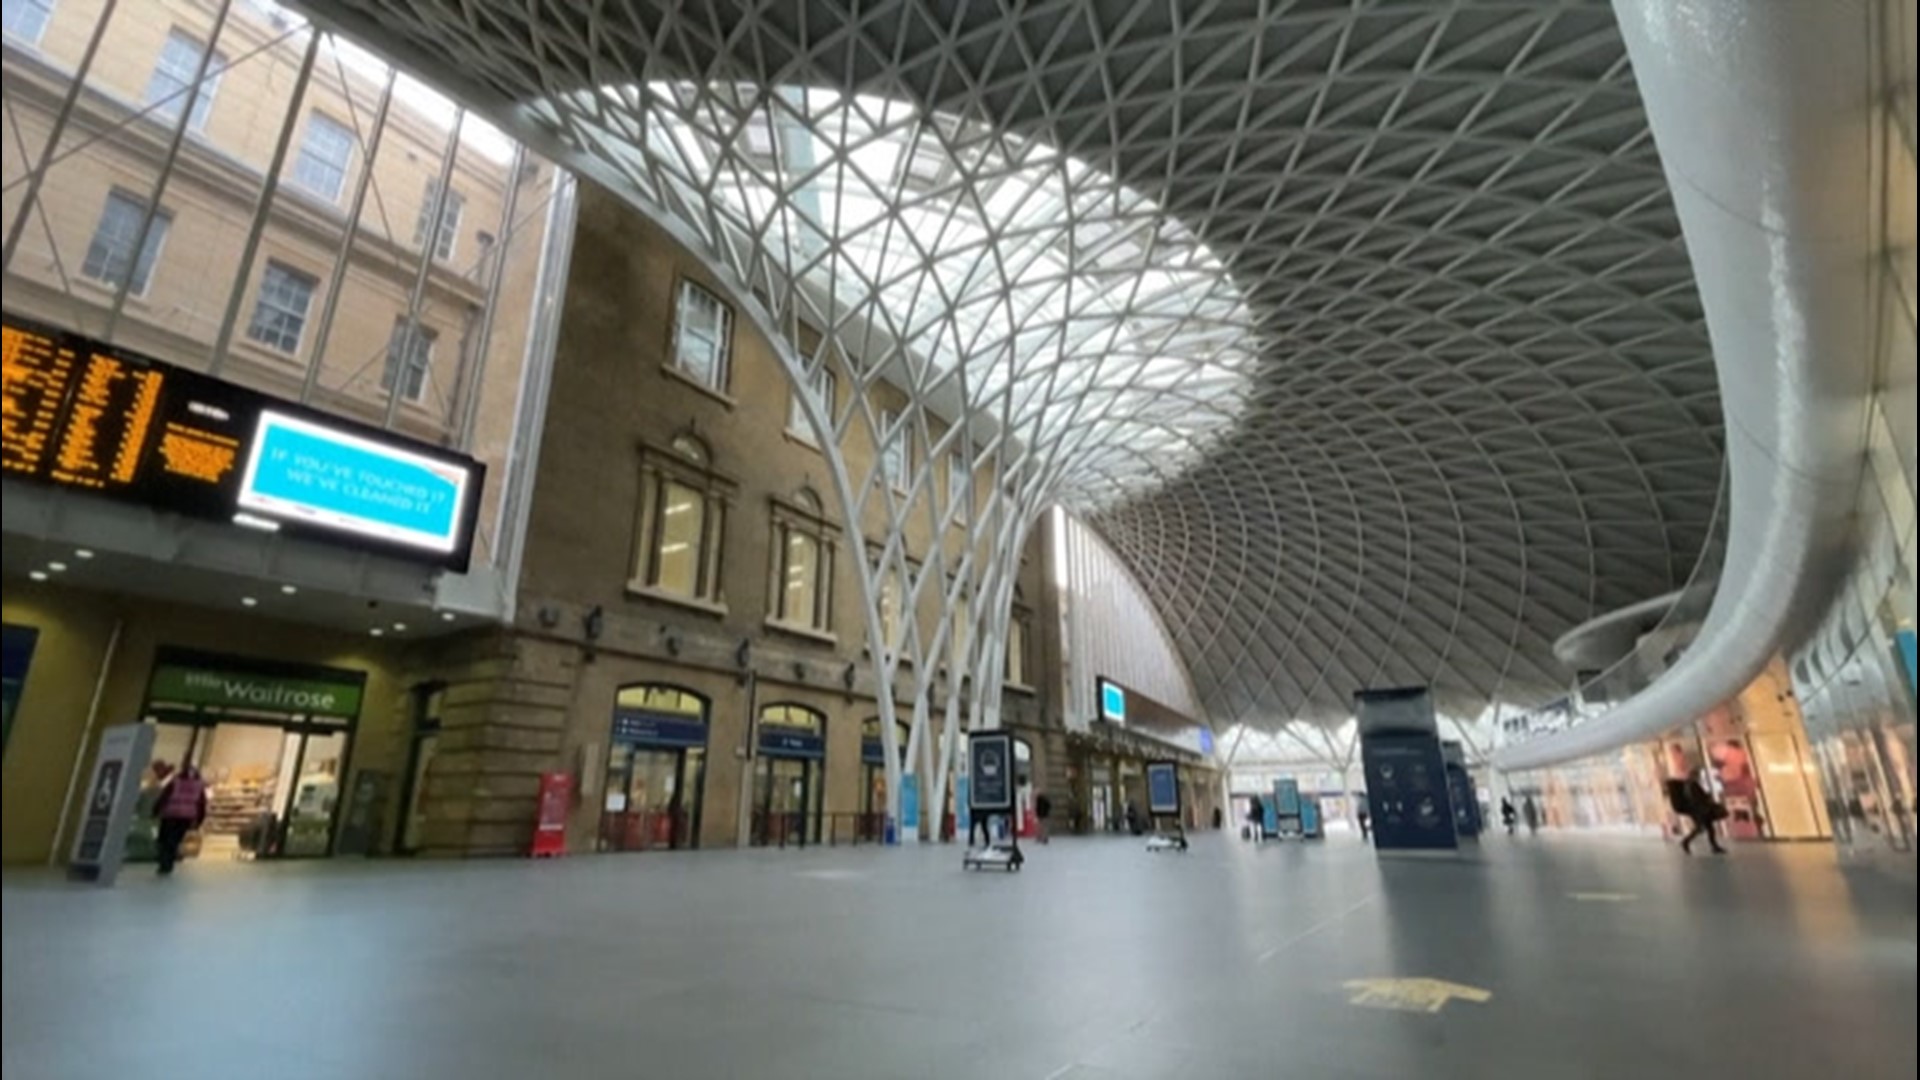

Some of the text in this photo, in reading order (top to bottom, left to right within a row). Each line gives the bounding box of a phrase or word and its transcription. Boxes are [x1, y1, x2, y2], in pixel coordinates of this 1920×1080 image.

[270, 447, 288, 461] IF
[294, 454, 352, 479] YOU'VE
[359, 470, 428, 499] TOUCHED
[431, 491, 446, 504] IT
[287, 468, 337, 491] WE'VE
[343, 483, 413, 510] CLEANED
[416, 501, 432, 514] IT
[224, 680, 336, 709] Waitrose
